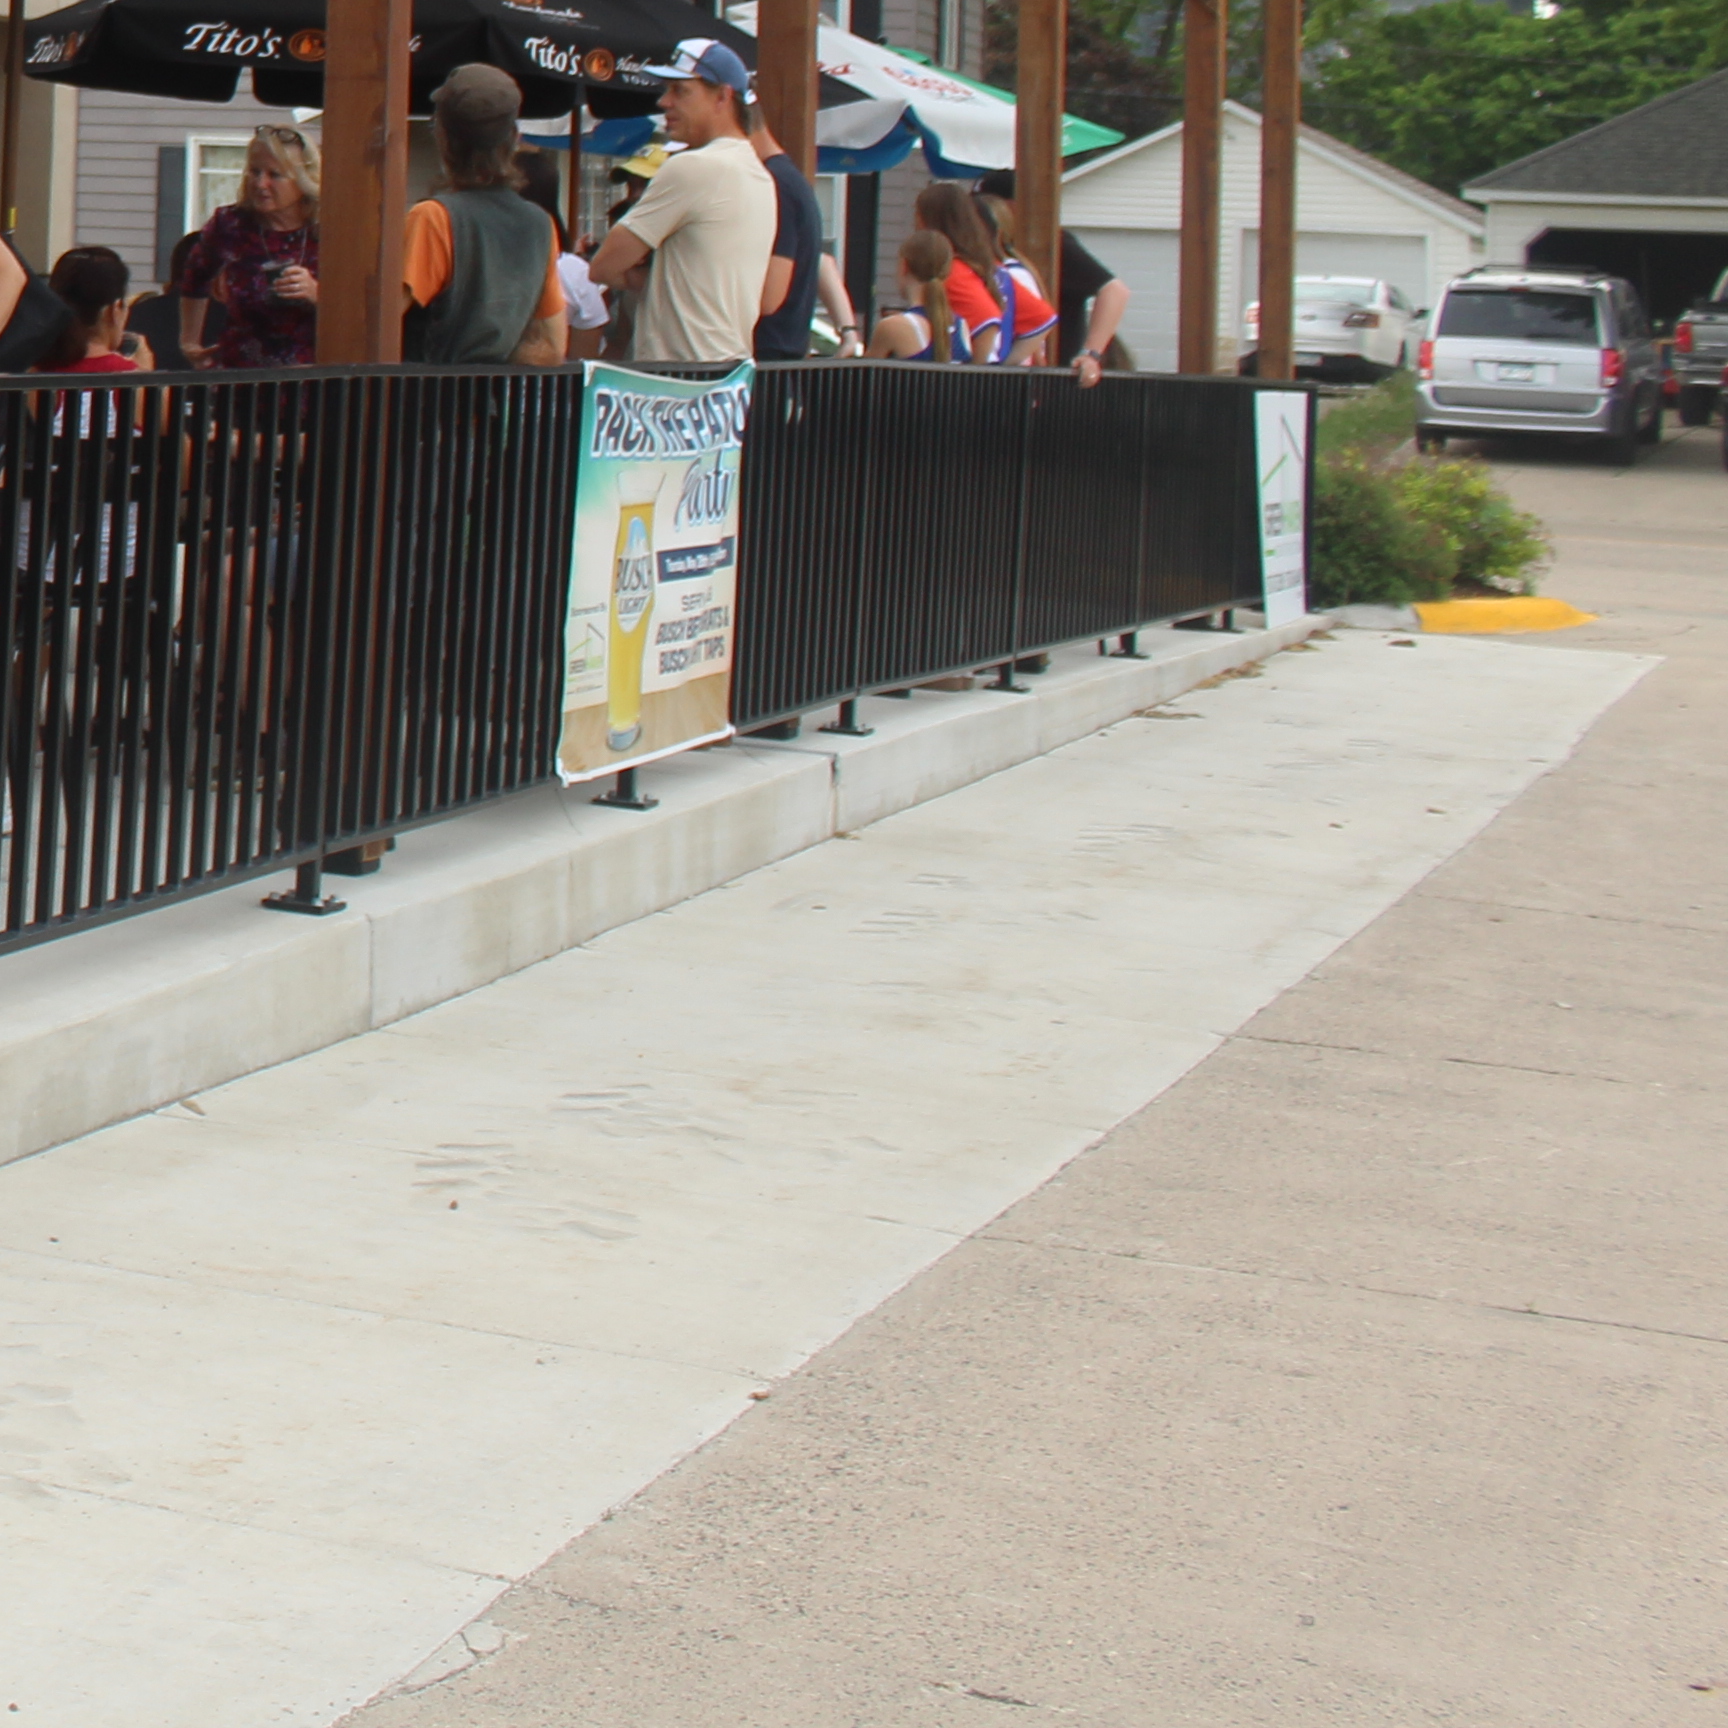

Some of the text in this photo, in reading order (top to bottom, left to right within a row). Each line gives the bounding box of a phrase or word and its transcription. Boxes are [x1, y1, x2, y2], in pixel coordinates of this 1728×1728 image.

[591, 387, 656, 458] PACK
[649, 395, 698, 457] THE
[615, 550, 652, 594] BUSC
